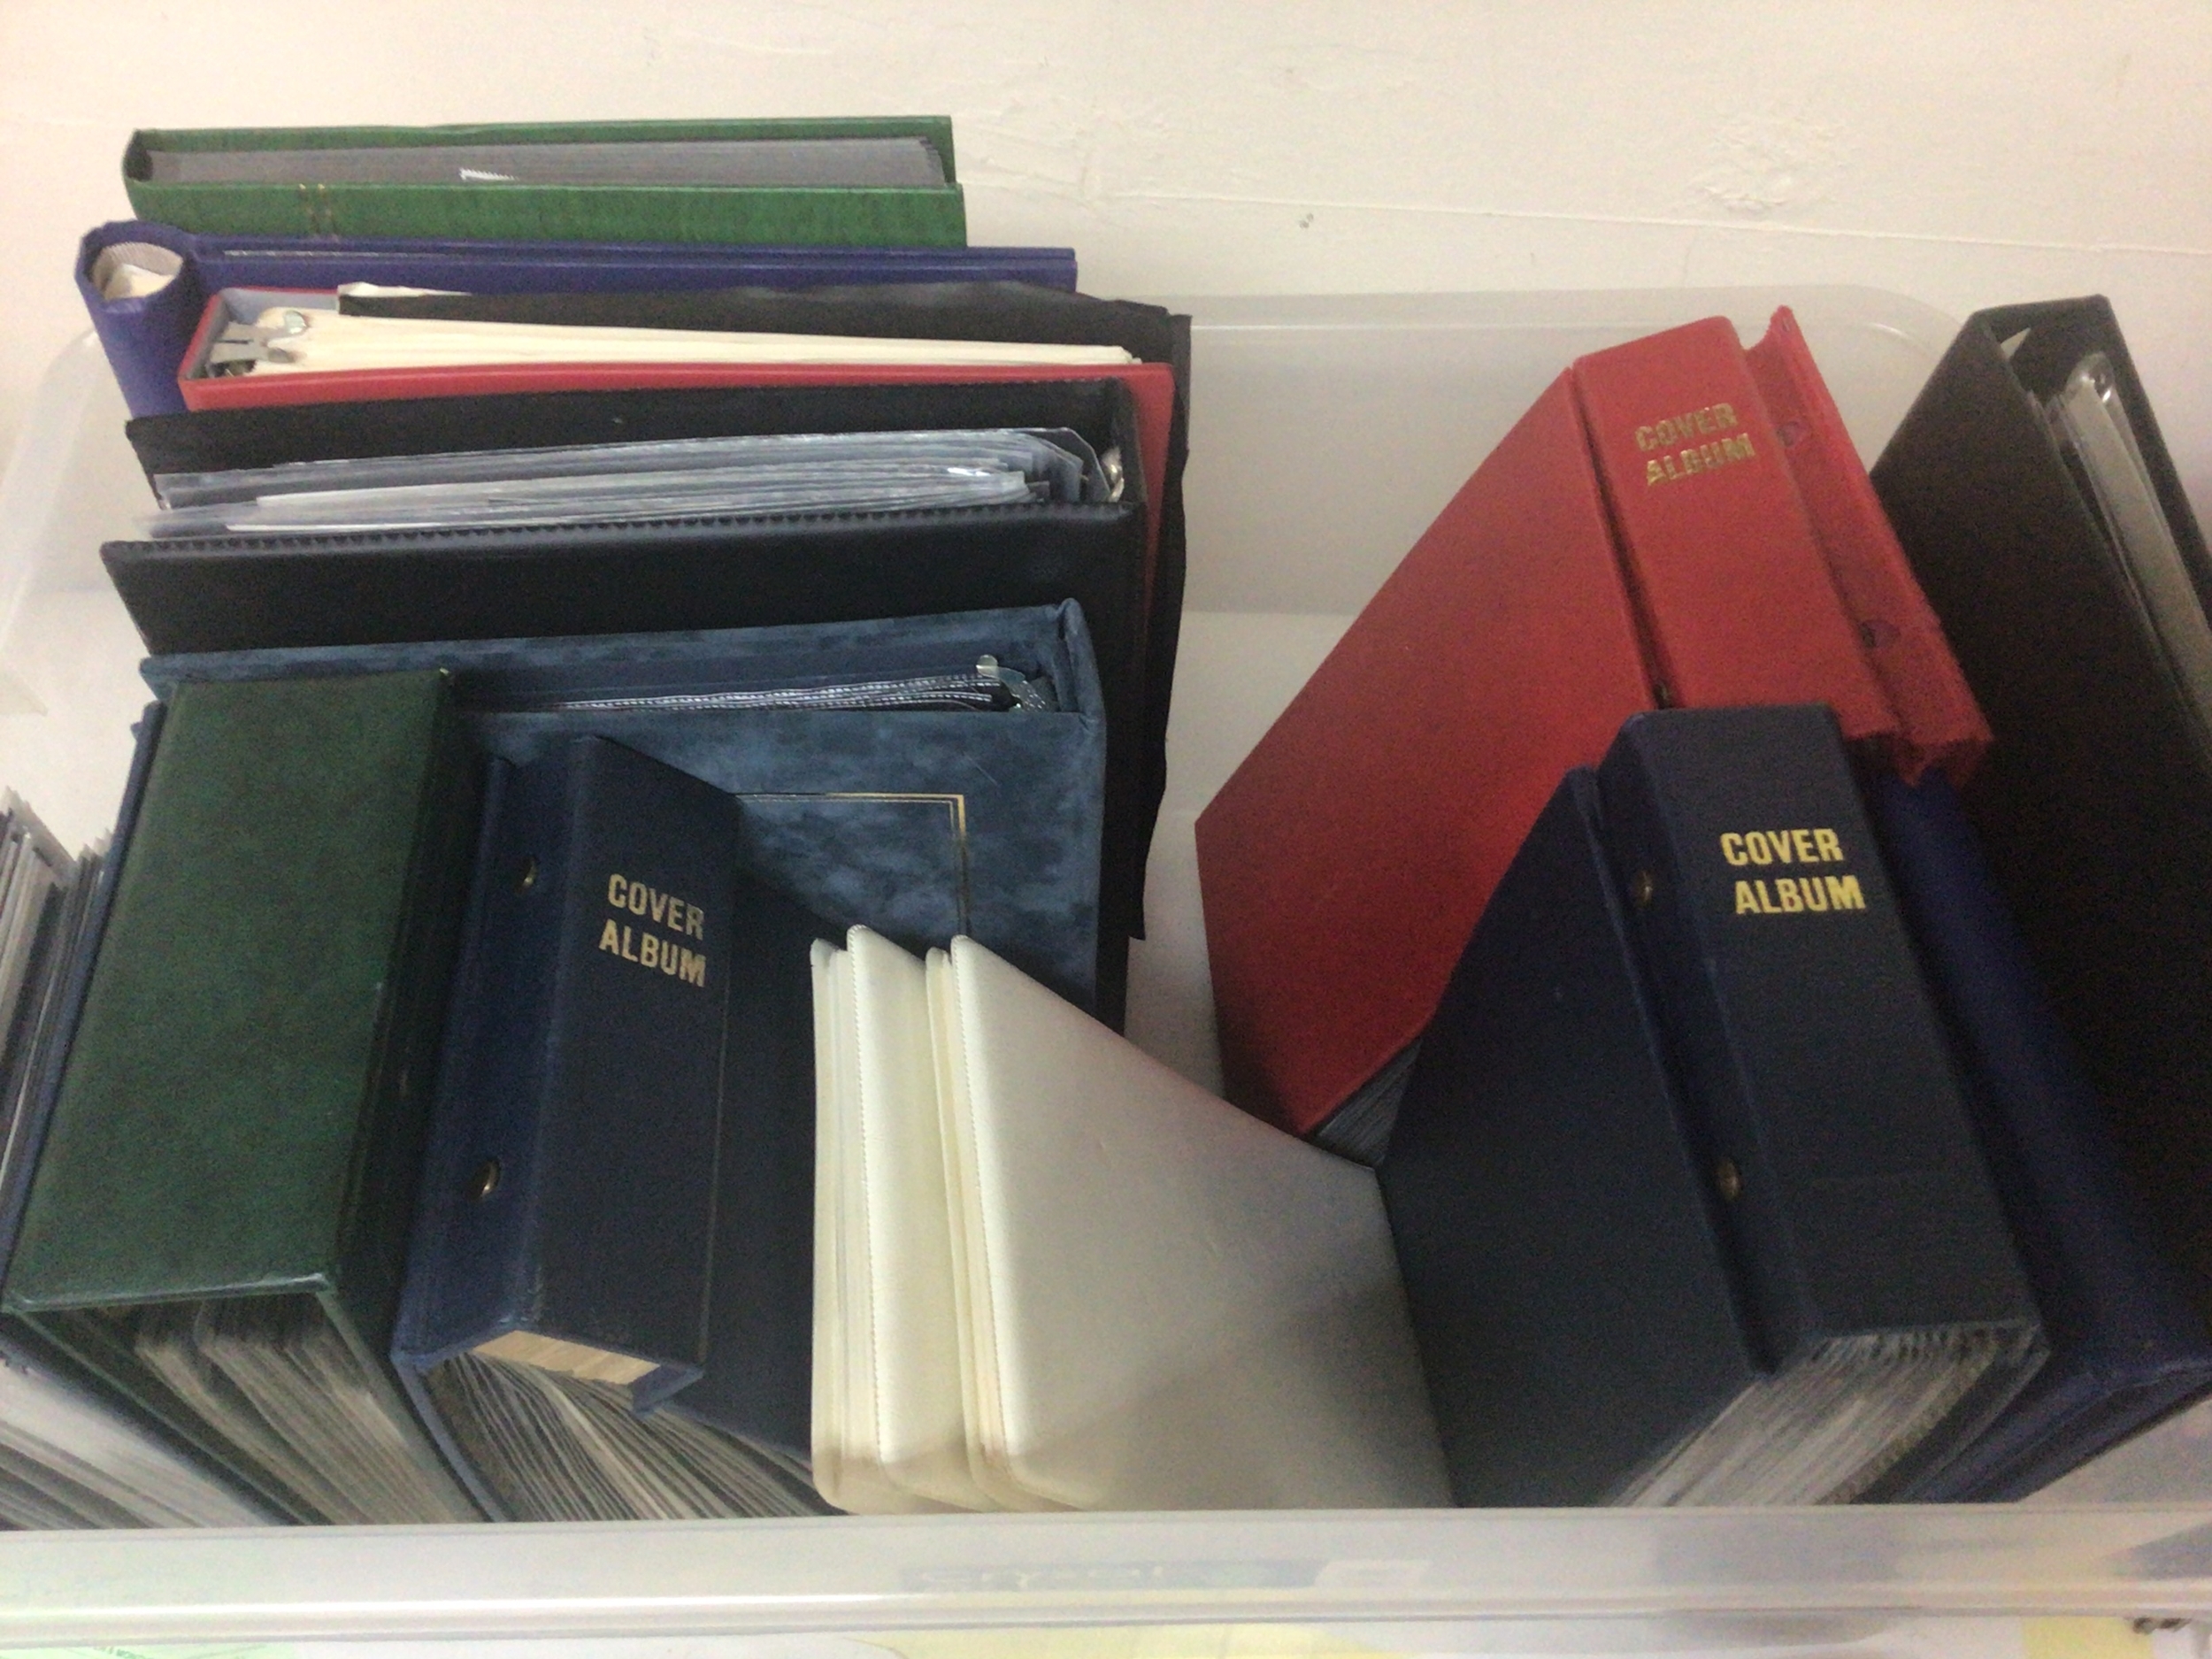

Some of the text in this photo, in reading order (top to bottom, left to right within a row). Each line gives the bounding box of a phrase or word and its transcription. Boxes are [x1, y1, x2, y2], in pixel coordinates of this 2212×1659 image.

[1720, 827, 1844, 866] COVER
[607, 873, 705, 941] COVER
[1735, 874, 1866, 915] ALBUM
[598, 918, 707, 987] ALBUM
